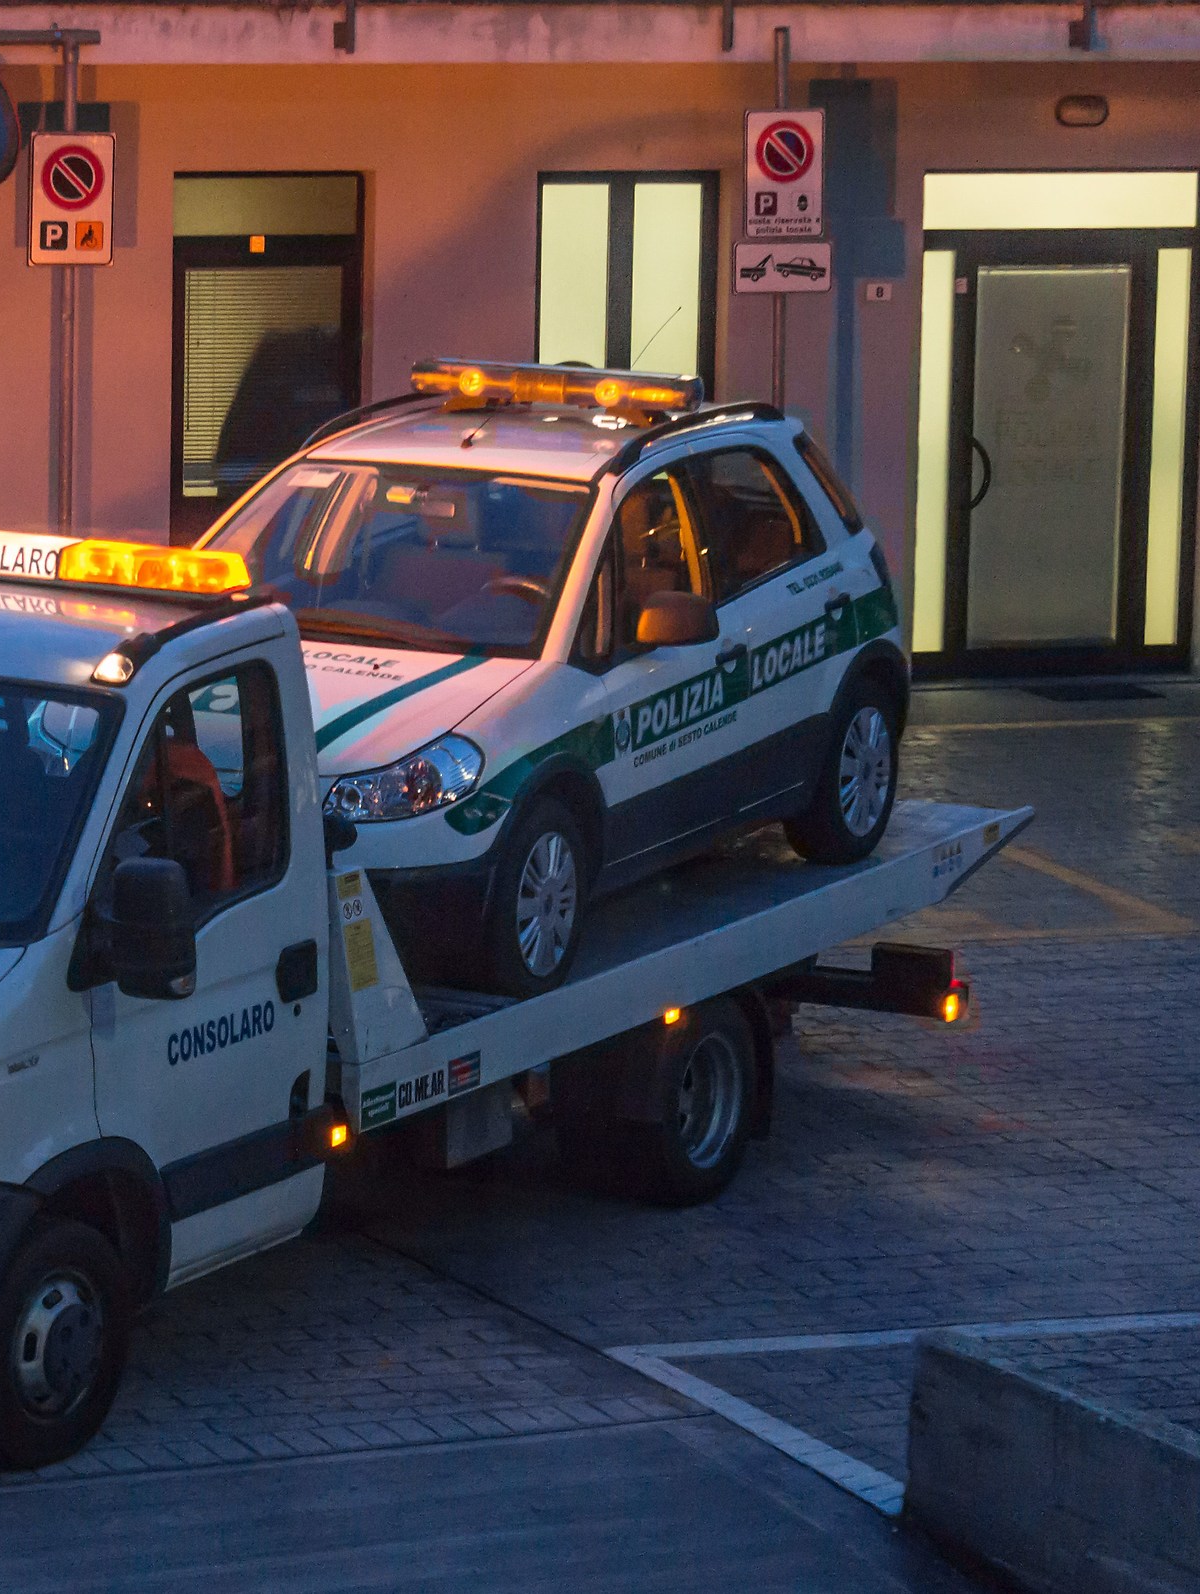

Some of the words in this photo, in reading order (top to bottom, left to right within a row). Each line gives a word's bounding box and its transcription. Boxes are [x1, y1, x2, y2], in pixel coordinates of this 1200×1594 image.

[322, 666, 404, 682] CALENDE
[636, 672, 724, 744] POLIZIA
[752, 623, 826, 689] LOCALE
[633, 743, 668, 768] COMUNE
[678, 726, 702, 749] SESTO
[703, 709, 738, 736] CALENDE
[167, 1000, 275, 1067] CONSOLARO
